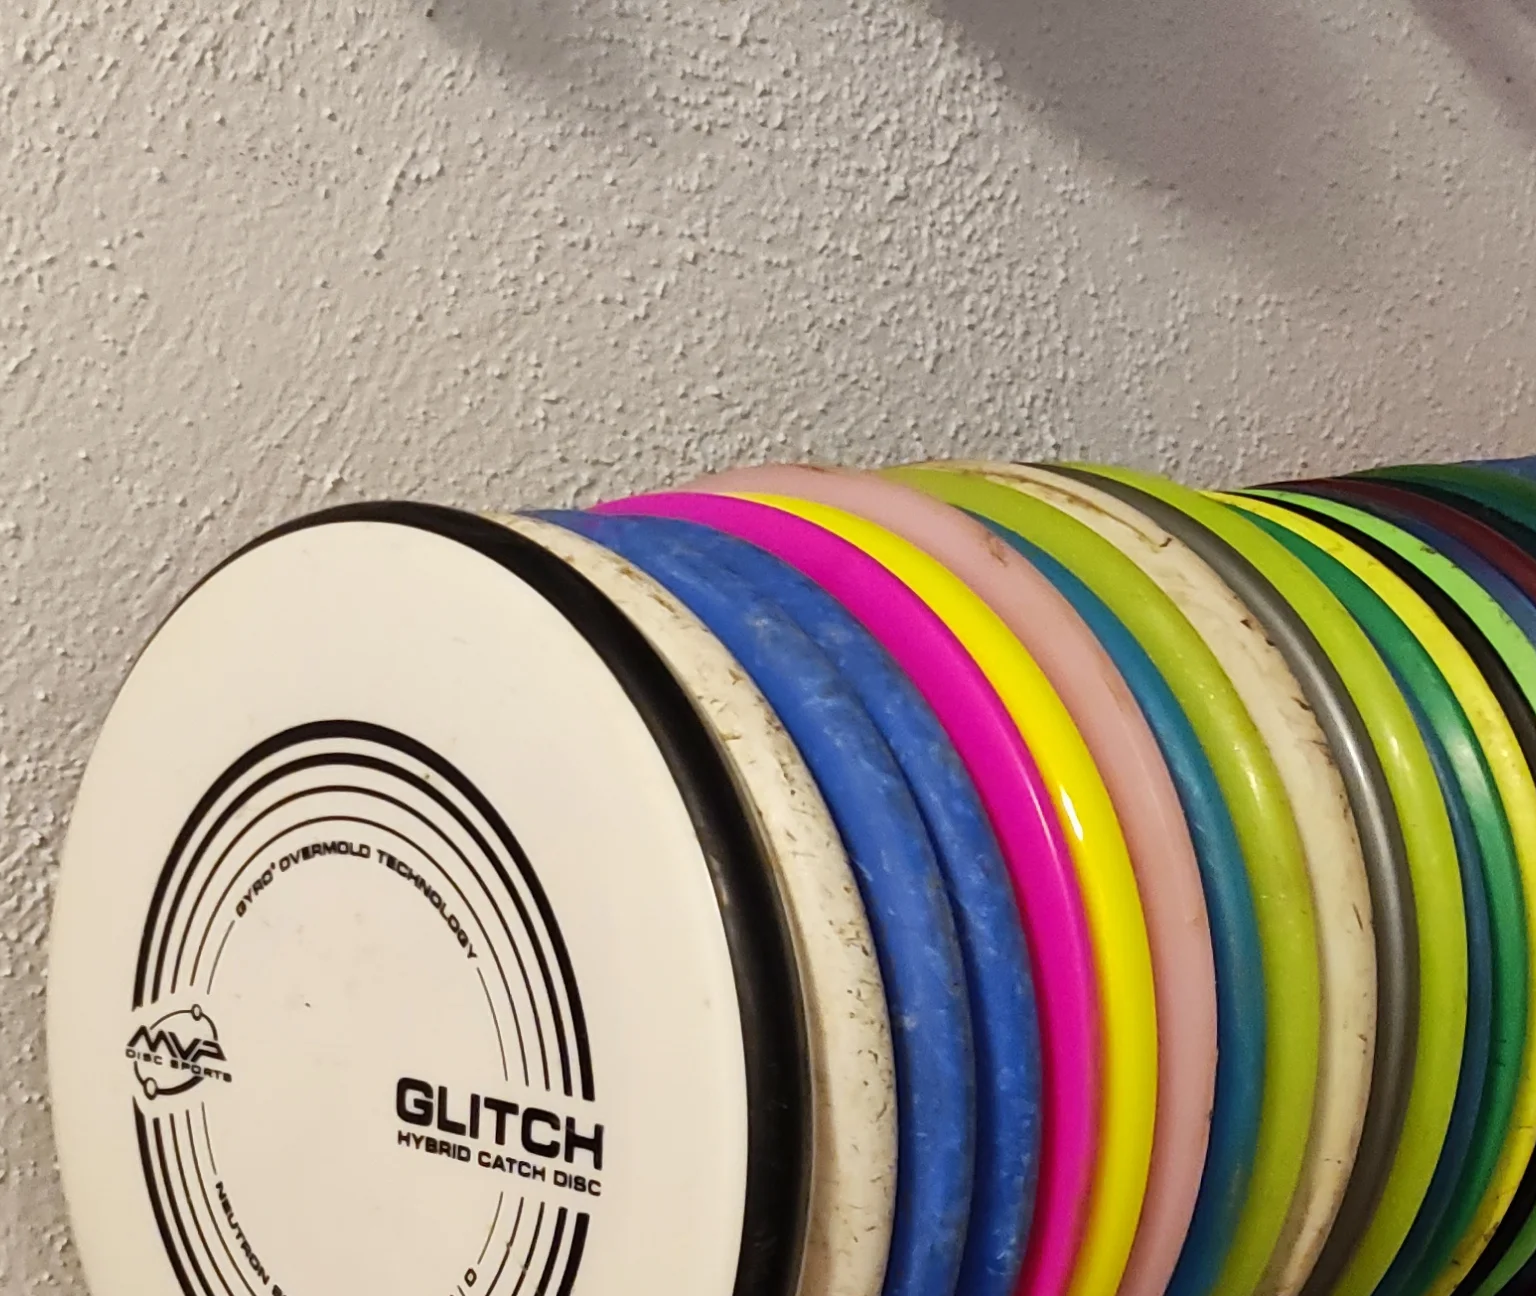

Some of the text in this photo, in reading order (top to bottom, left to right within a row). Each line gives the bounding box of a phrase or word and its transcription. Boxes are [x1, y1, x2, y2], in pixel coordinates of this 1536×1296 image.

[279, 841, 371, 872] OVERMOLD
[376, 849, 478, 959] TECHNOLOGY
[125, 1048, 163, 1065] DISC
[127, 1025, 227, 1062] MVP
[396, 1077, 604, 1171] GLITCH
[397, 1130, 602, 1197] HYBRID CATCH DISC
[215, 1181, 270, 1285] NEUTRON
